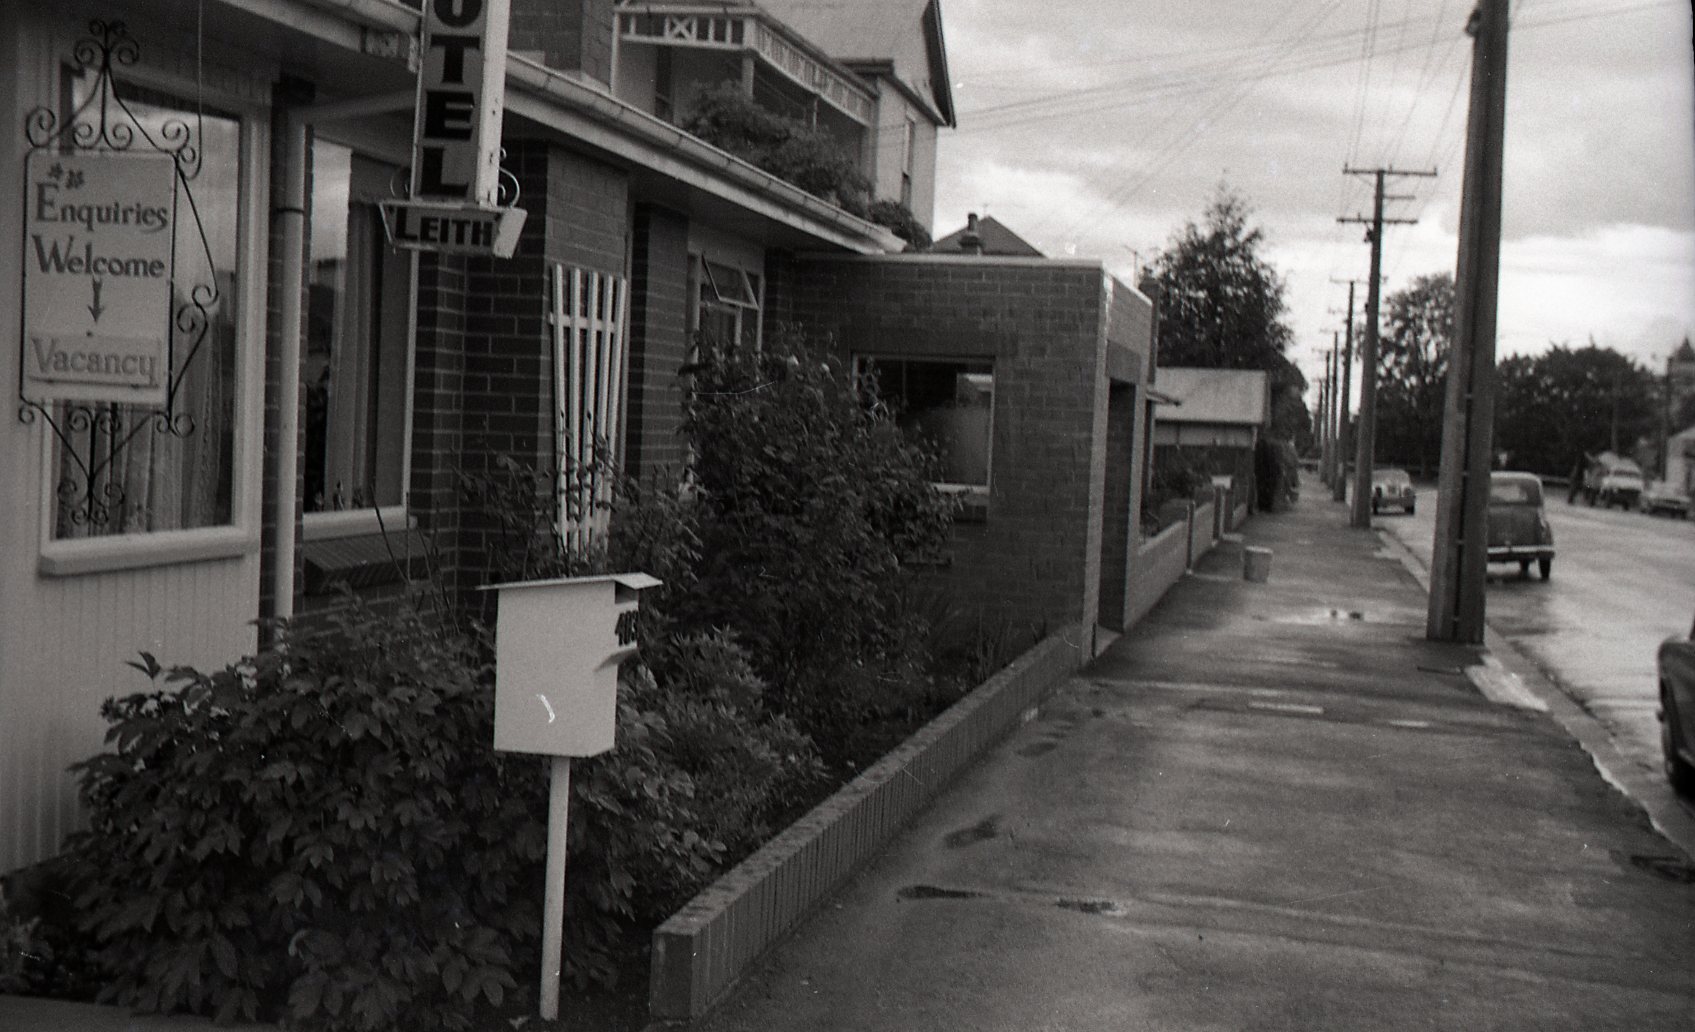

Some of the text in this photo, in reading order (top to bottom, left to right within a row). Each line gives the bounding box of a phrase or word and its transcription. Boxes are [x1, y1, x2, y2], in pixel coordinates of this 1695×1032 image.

[35, 181, 168, 233] Enquiries
[395, 206, 493, 247] LEITH
[32, 234, 165, 277] Welcome
[31, 337, 156, 383] Vacancy
